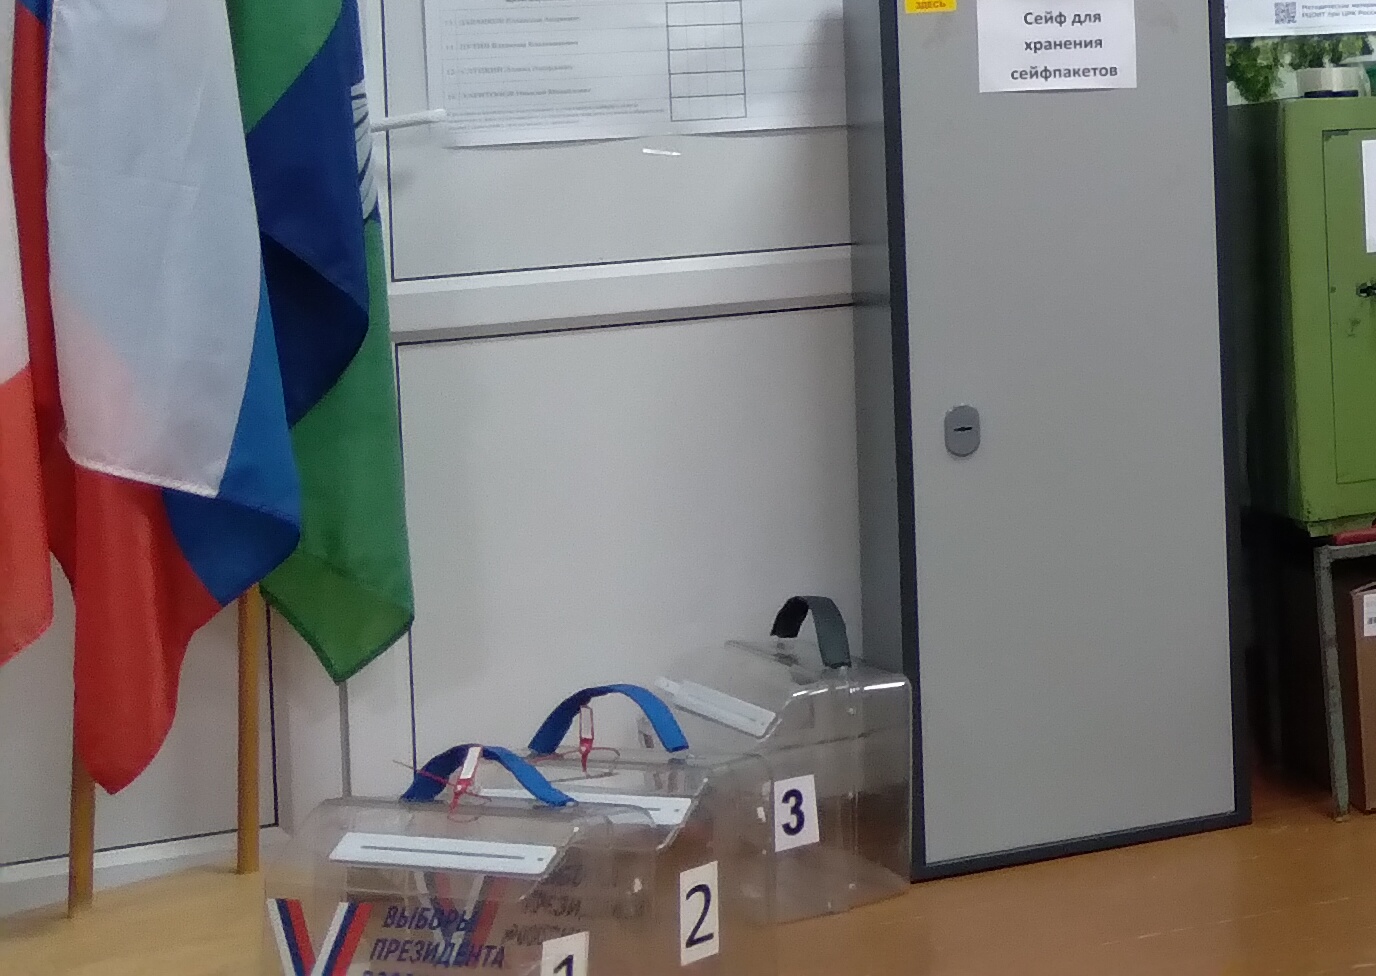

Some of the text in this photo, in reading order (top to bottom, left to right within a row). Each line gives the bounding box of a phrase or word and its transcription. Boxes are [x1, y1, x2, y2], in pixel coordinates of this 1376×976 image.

[916, 1, 946, 10] ЗДЕСЬ
[1023, 10, 1101, 27] Сейф для
[1024, 38, 1103, 54] хранения
[1010, 66, 1118, 82] сейфпакетов
[781, 789, 804, 836] 3
[682, 883, 714, 950] 2
[370, 938, 505, 968] ПРЕЗИДЕНТА
